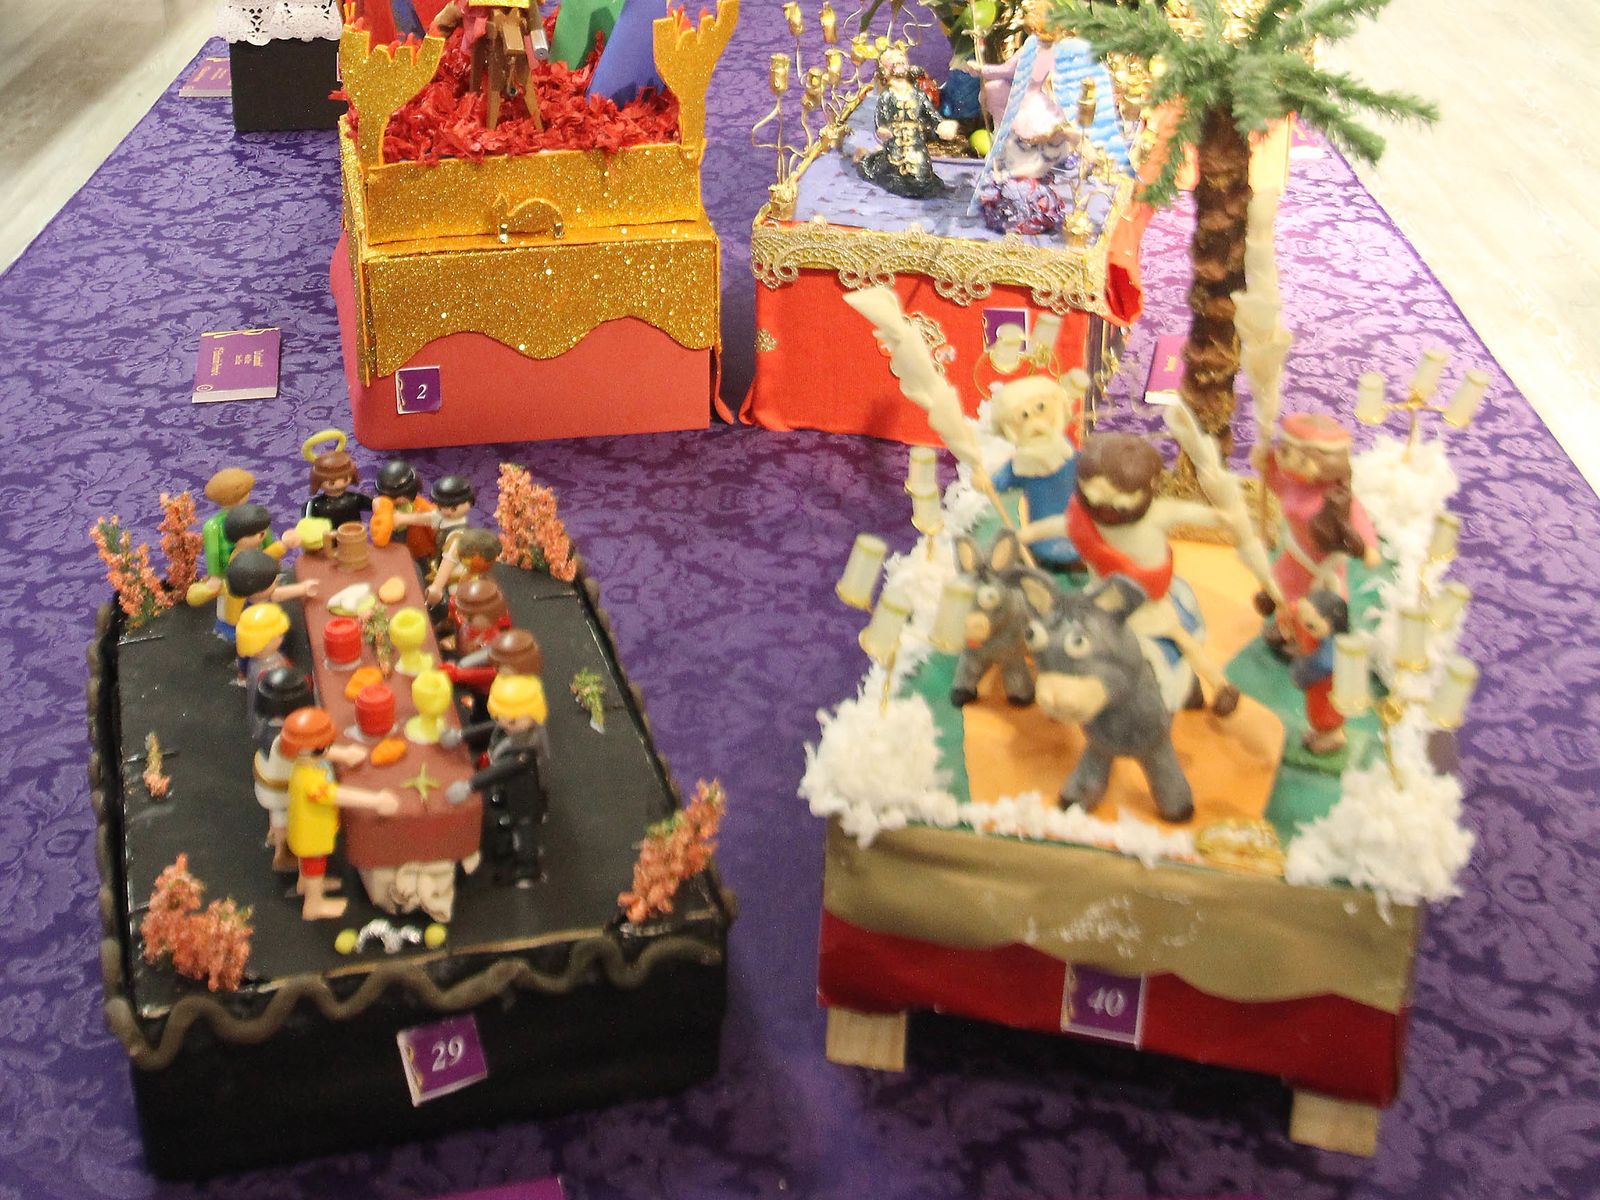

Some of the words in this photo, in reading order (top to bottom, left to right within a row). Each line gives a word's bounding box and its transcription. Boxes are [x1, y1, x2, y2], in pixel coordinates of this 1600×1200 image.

[416, 384, 428, 400] 2
[1087, 986, 1126, 1017] 40
[431, 1034, 465, 1073] 29
